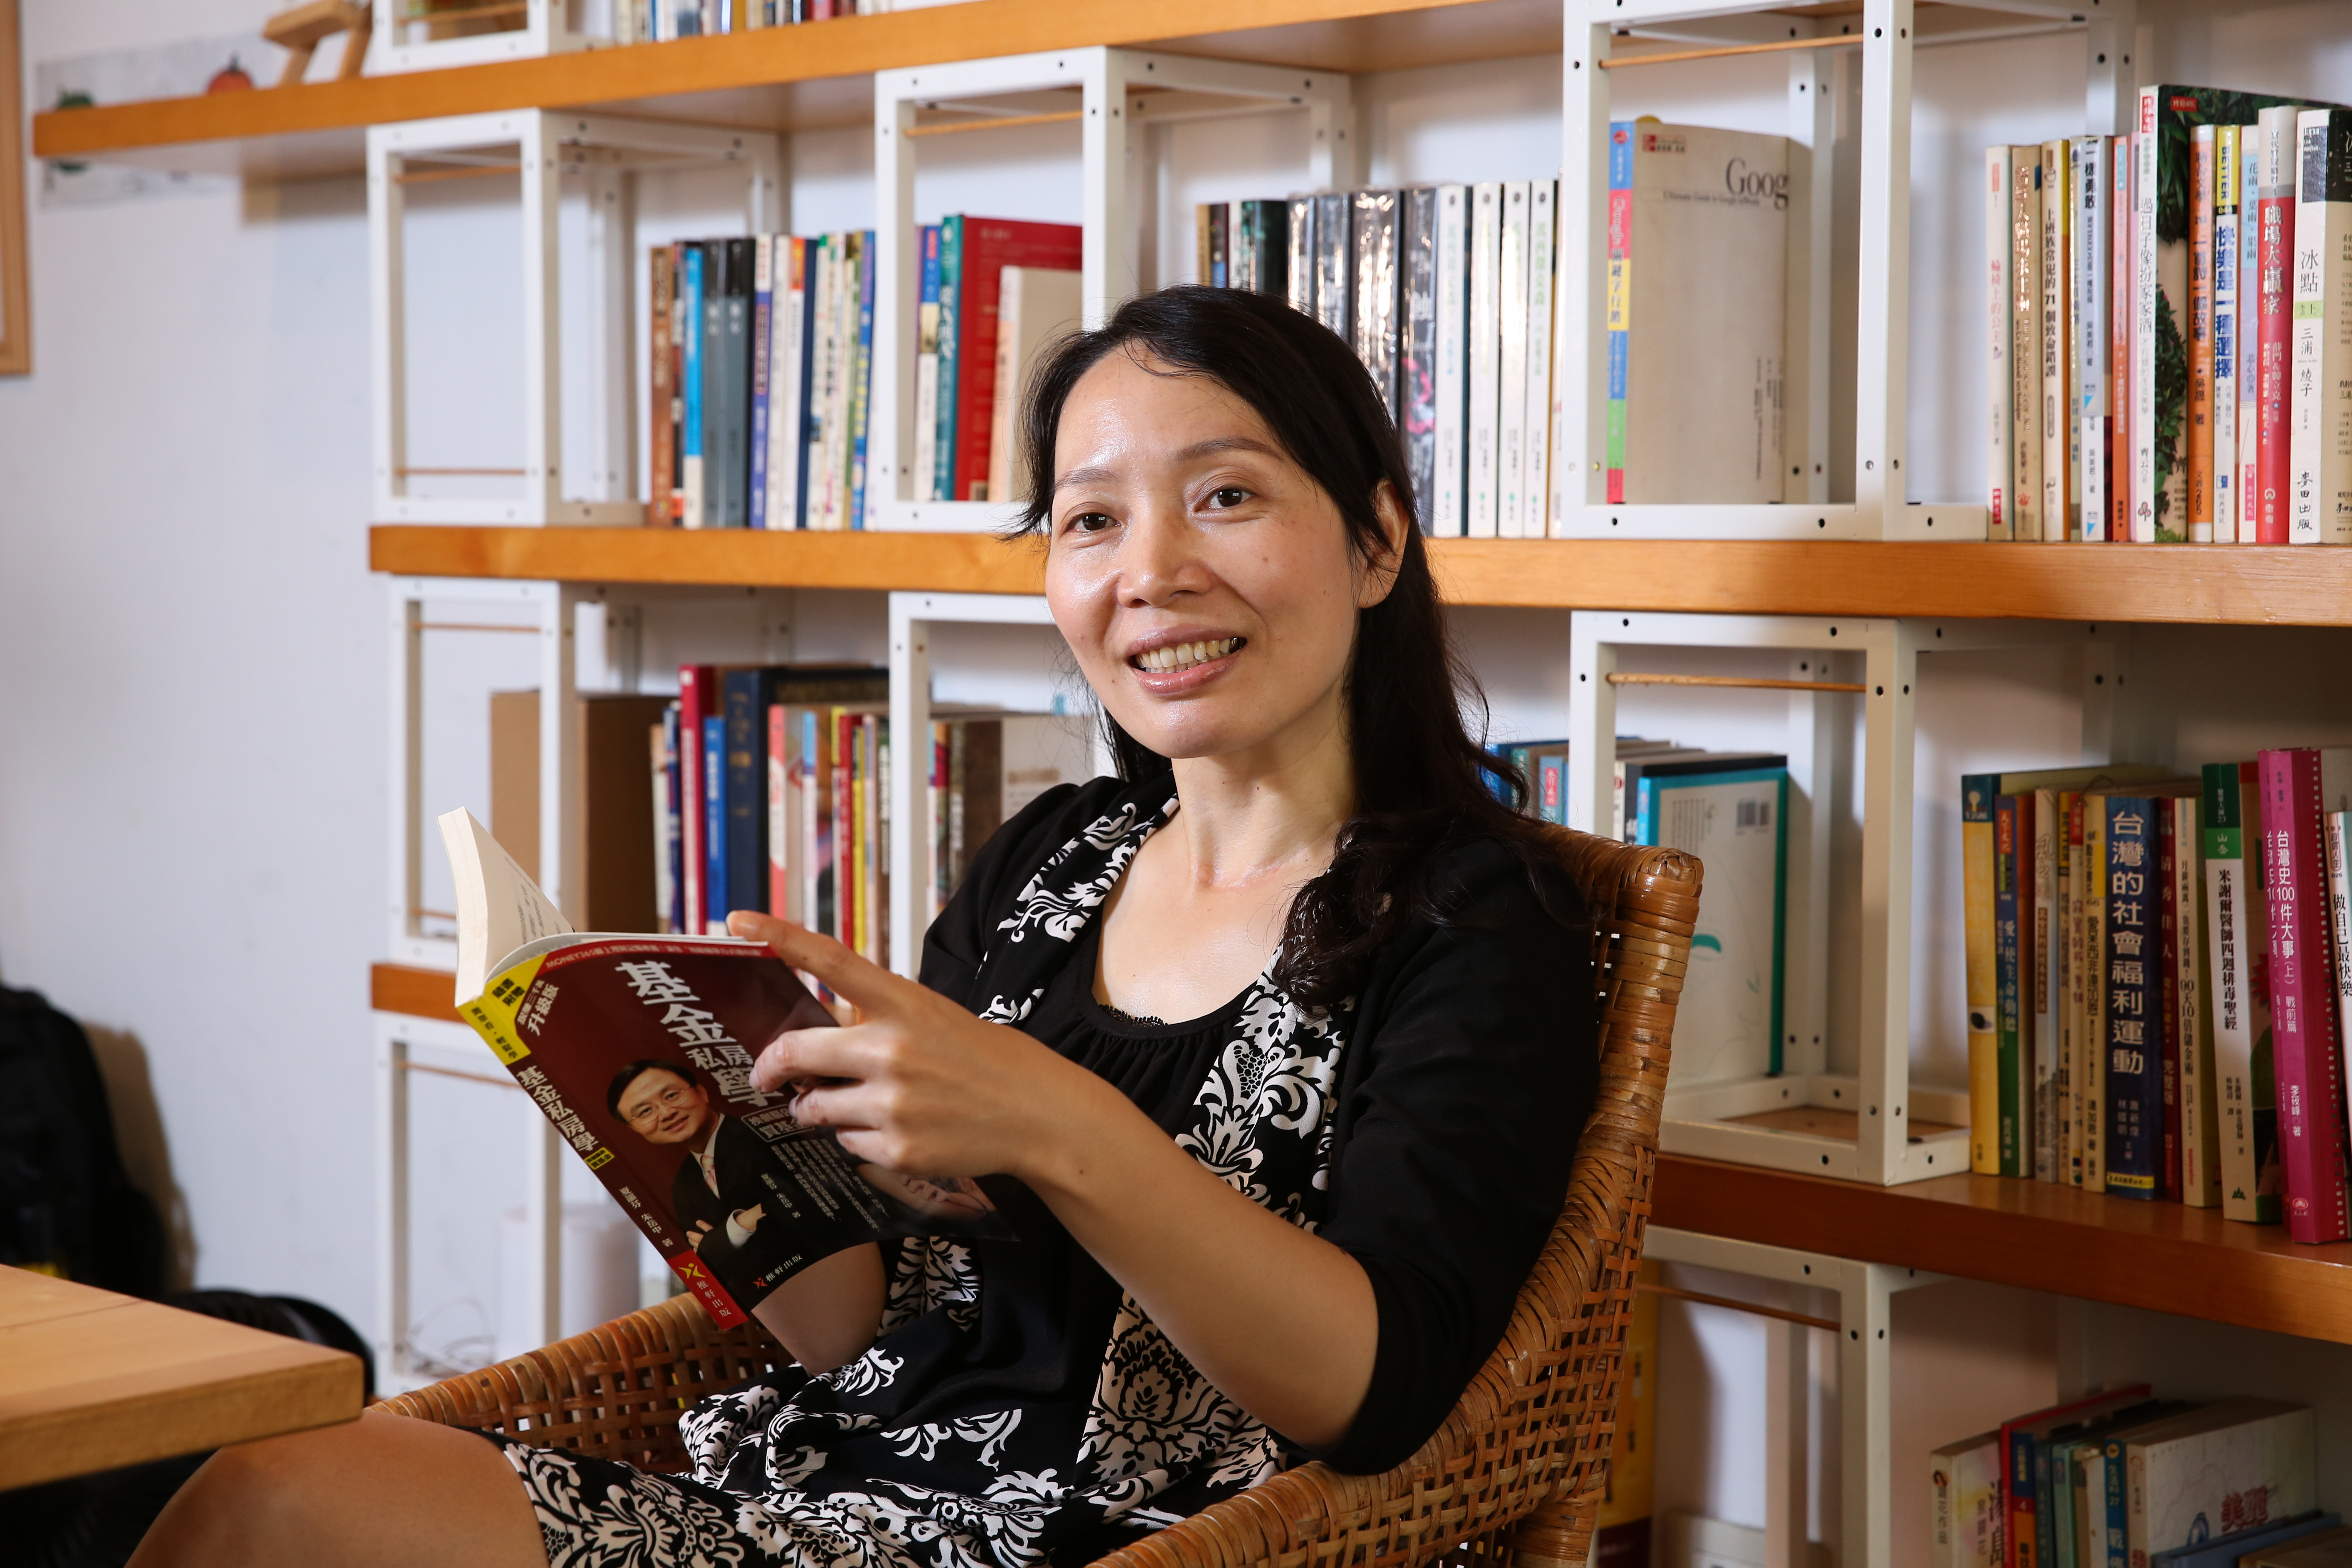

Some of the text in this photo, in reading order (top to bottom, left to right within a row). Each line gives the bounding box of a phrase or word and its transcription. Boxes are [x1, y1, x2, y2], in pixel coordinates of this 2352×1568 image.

[2221, 146, 2230, 200] BETTER
[2262, 205, 2283, 315] 職場大贏家
[2300, 249, 2318, 293] 冰點
[2215, 225, 2235, 378] 快樂是一種選擇
[2300, 327, 2314, 355] 三浦
[2300, 369, 2314, 398] 綾子
[2298, 470, 2313, 532] 麥田出版
[2331, 832, 2340, 867] 自信人生
[2112, 811, 2145, 1075] 台灣的社會福利運動
[2219, 869, 2238, 1031] 米謝爾醫師四週排毒聖經
[2332, 894, 2352, 997] 做自己最快樂
[527, 983, 560, 1036] 升級版
[2286, 995, 2297, 1034] 戰前篇
[516, 1065, 599, 1152] 基金私房學
[640, 1213, 662, 1235] 朱岳中
